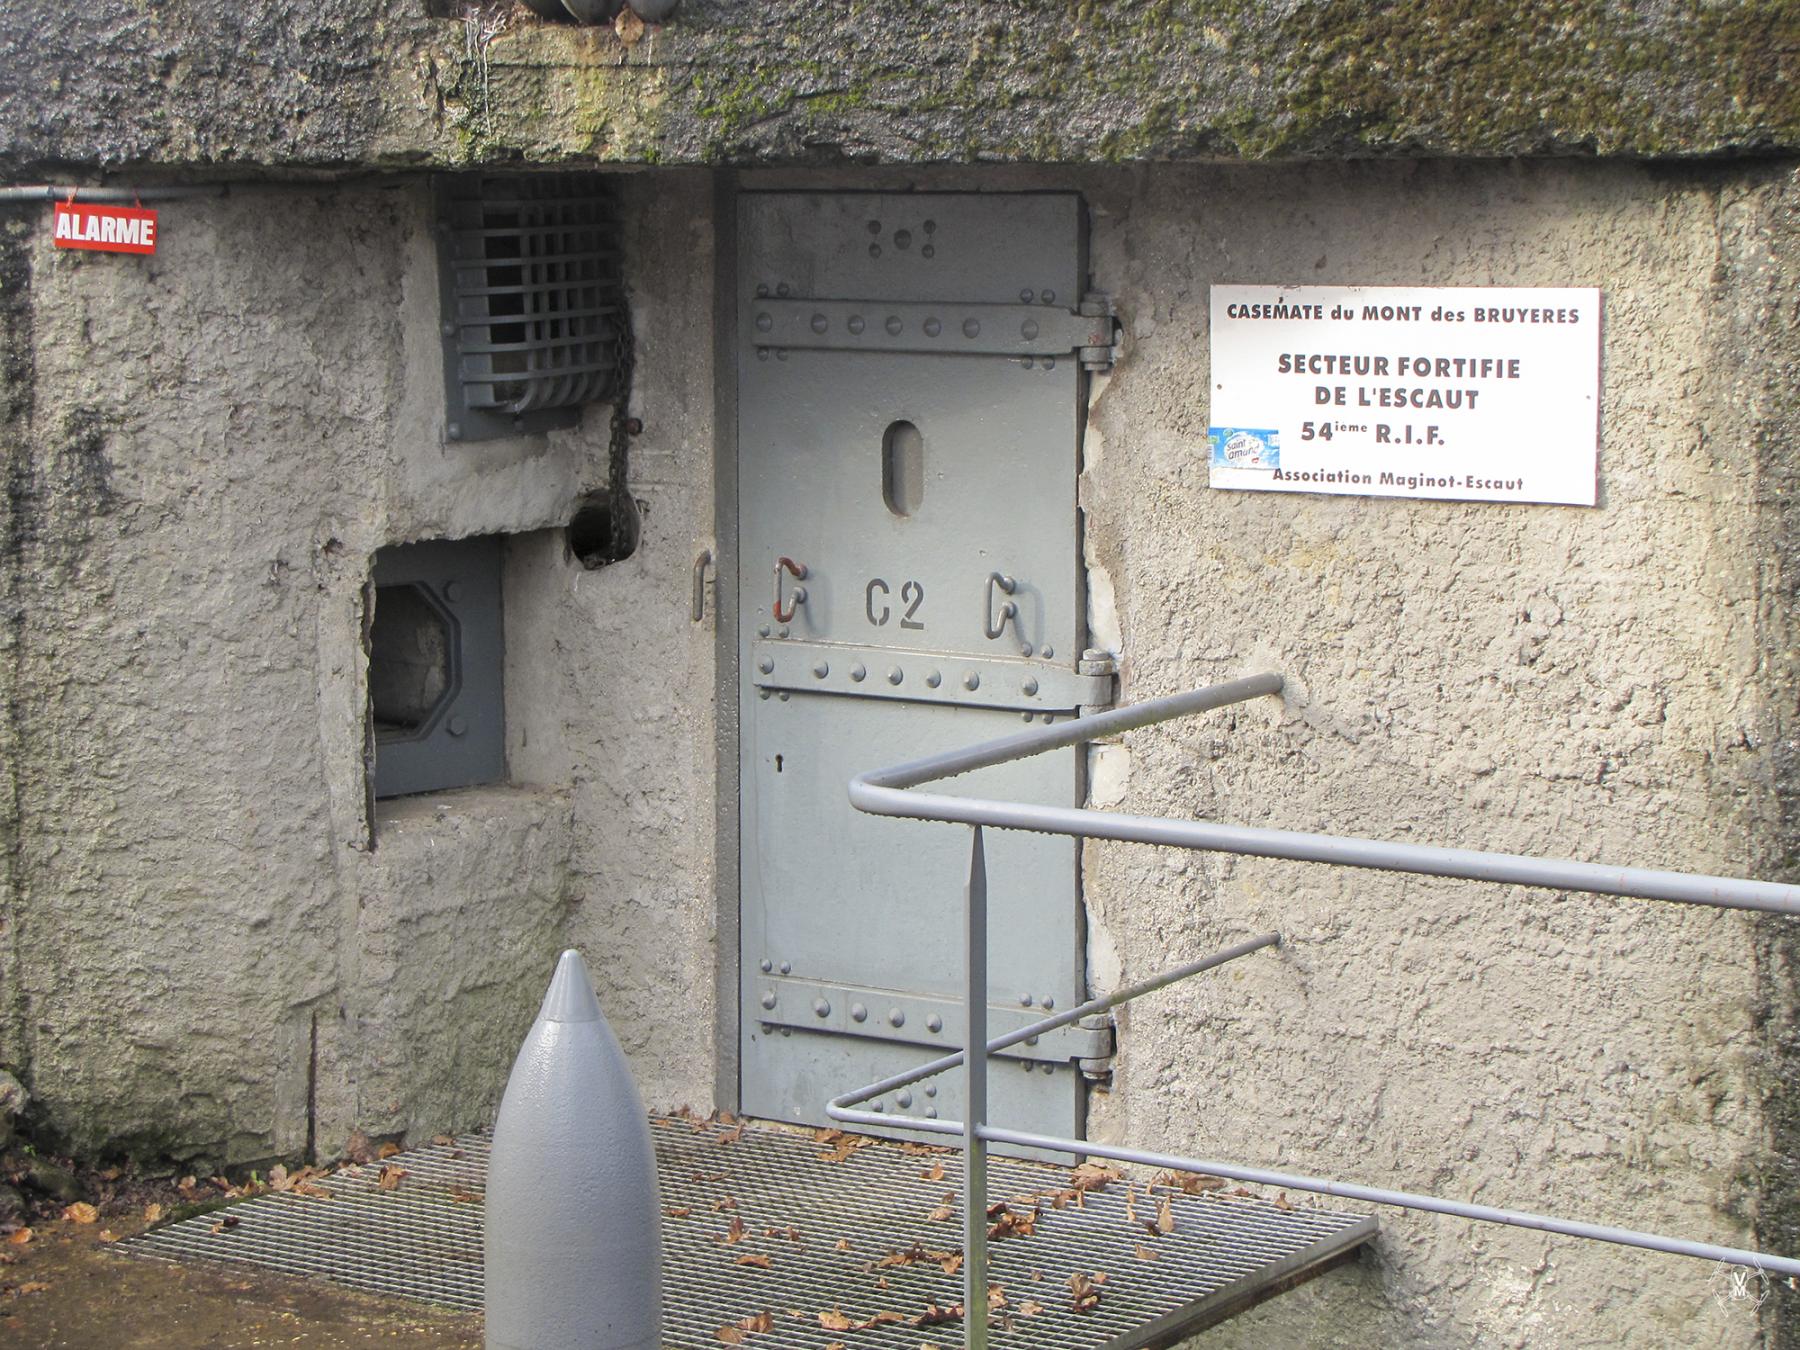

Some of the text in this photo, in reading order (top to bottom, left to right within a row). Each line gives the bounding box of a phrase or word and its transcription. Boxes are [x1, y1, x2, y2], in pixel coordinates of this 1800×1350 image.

[56, 213, 154, 246] ALARME
[1227, 303, 1580, 324] CASEMATE du MONT des BRUYERES
[1278, 353, 1520, 379] SECTEUR FORTIFIE
[1315, 386, 1479, 410] DE L'ESCAUT
[1376, 424, 1445, 446] R.I.F.
[1272, 468, 1523, 490] Association Maginot-Escaut
